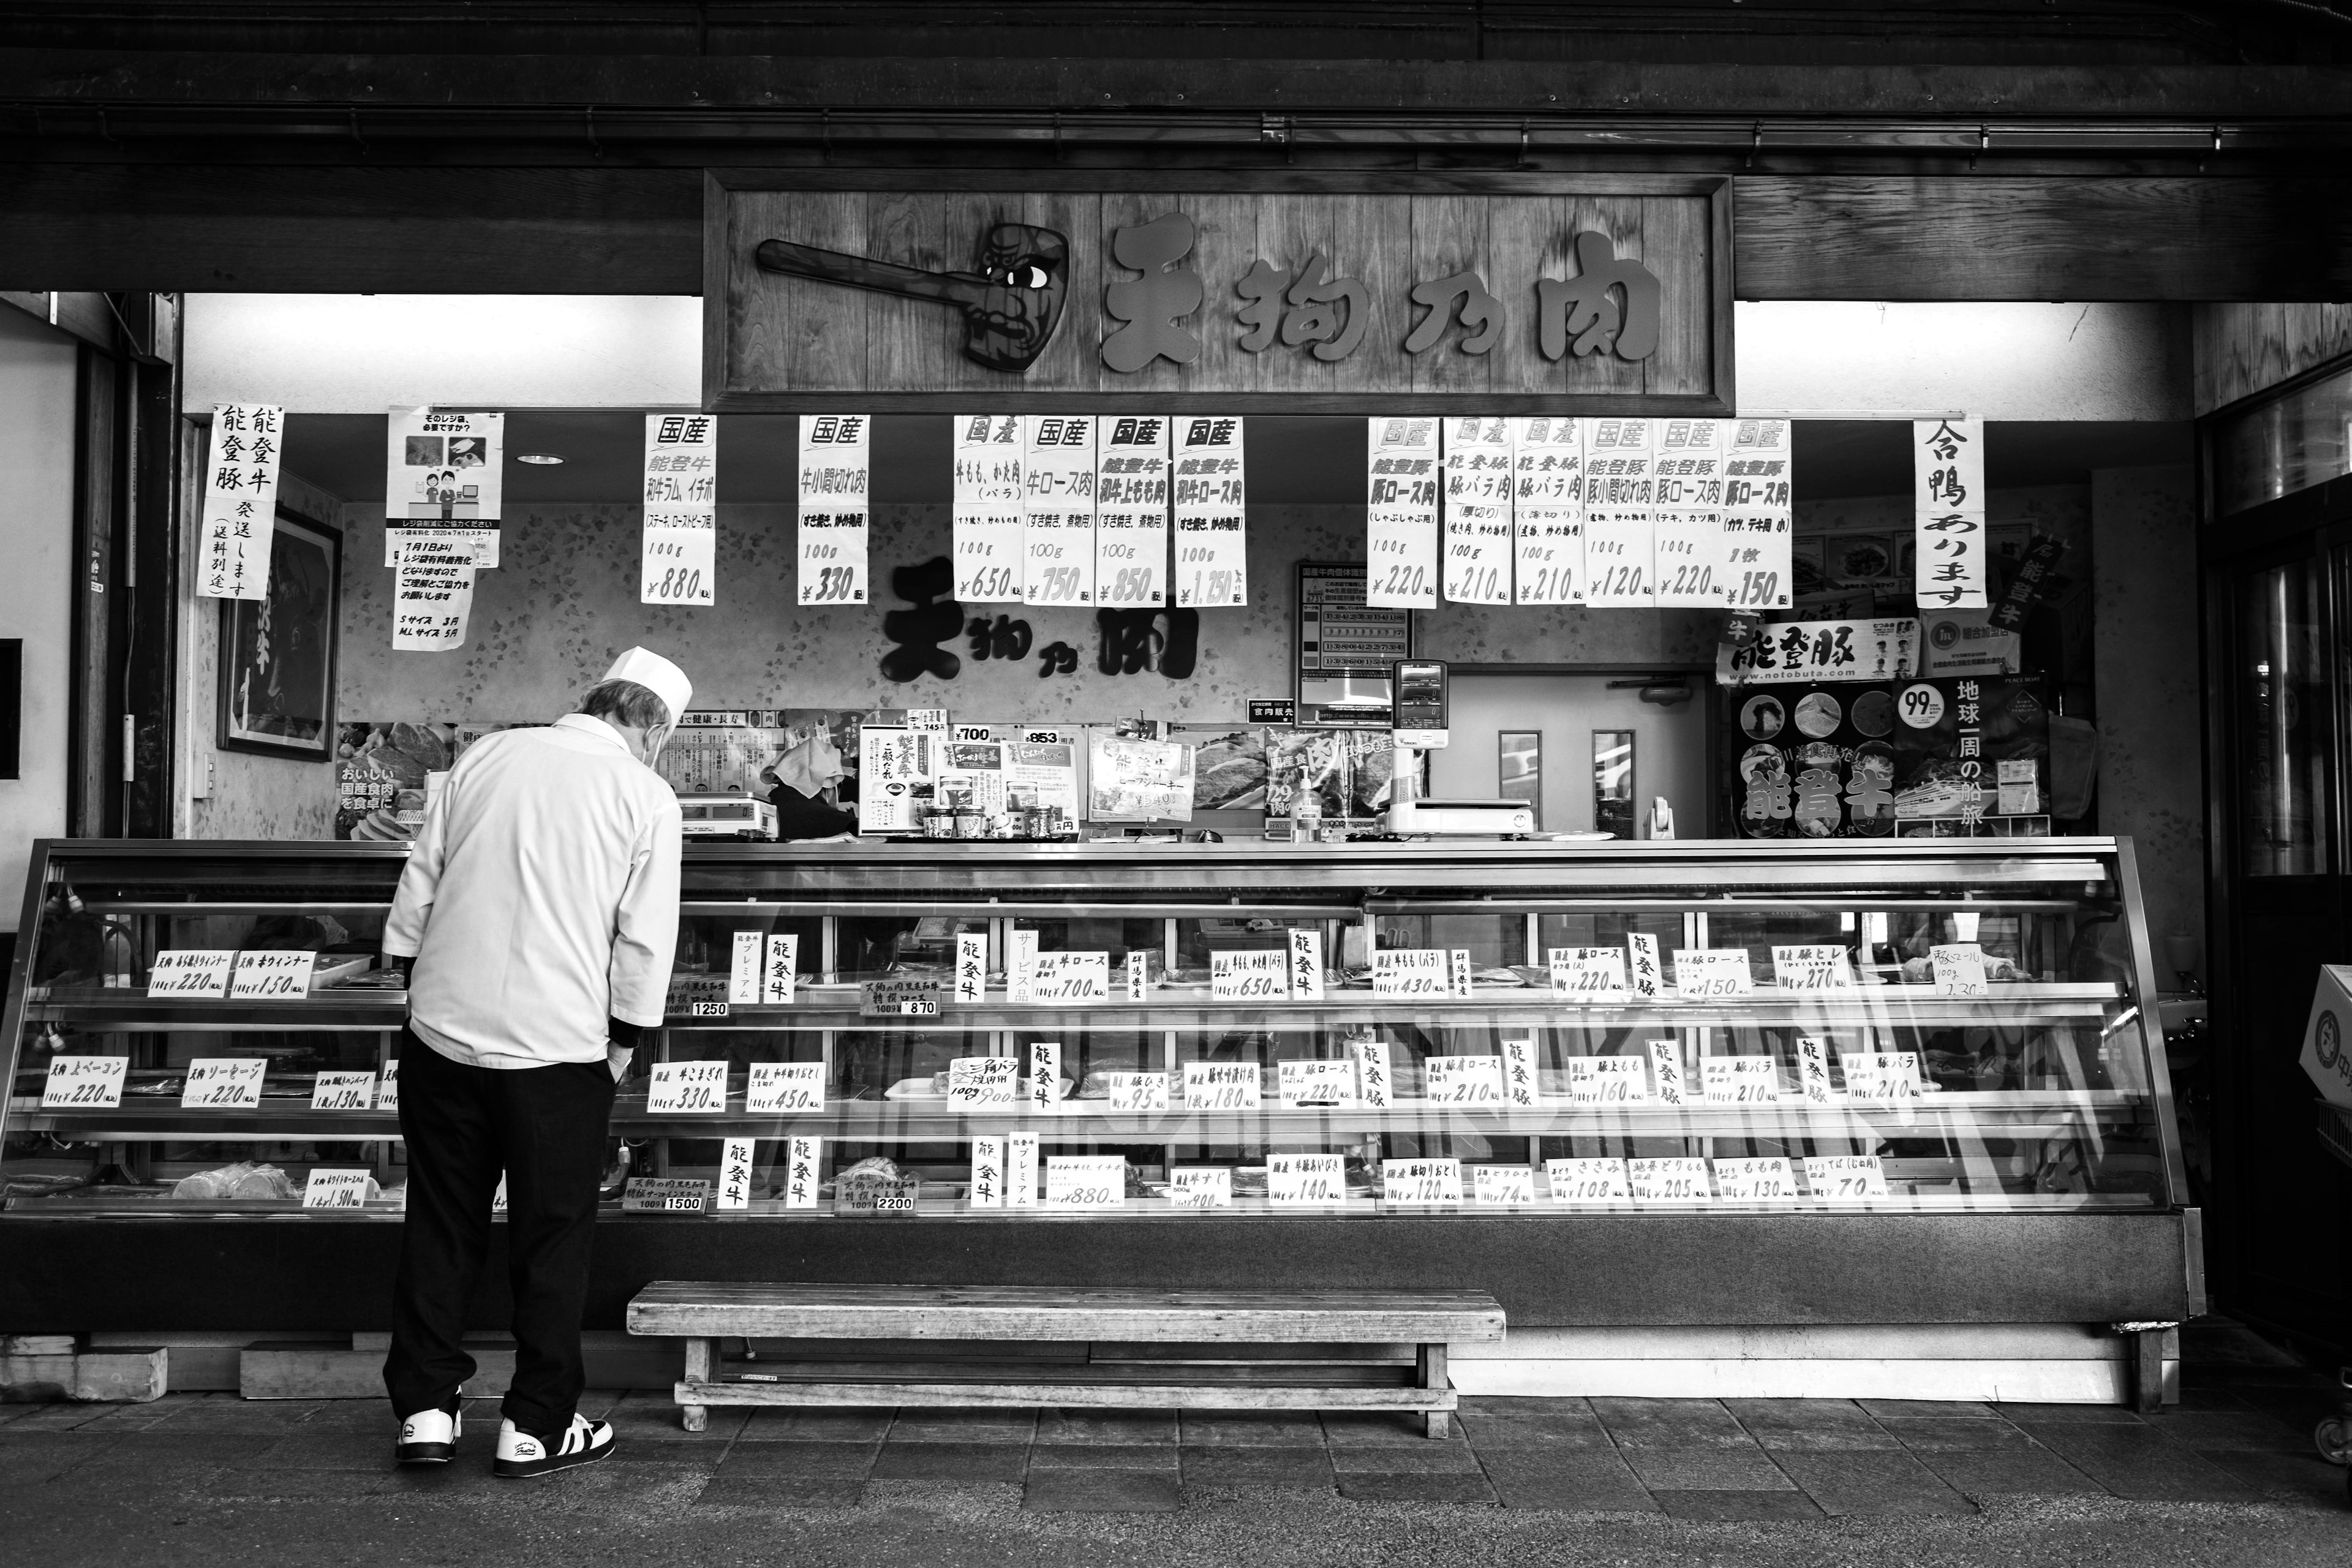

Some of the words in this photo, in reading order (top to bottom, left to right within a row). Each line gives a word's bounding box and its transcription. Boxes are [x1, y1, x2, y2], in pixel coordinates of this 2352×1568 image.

[1101, 212, 1660, 372] 天狗乃肉
[425, 415, 469, 423] そのレジ袋、
[657, 417, 710, 443] 国産
[811, 417, 864, 443] 国産
[966, 416, 1017, 443] 国産
[1037, 419, 1088, 445] 国産
[1110, 418, 1162, 445] 国産
[1456, 418, 1507, 442] 国産
[1526, 417, 1576, 443] 国産
[1185, 419, 1236, 446] 国産
[1381, 420, 1432, 445] 国産
[1595, 420, 1646, 447] 国産
[1664, 421, 1715, 447] 国産
[1733, 421, 1784, 447] 国産
[216, 405, 246, 489] 能登豚
[247, 408, 276, 494] 能登牛
[647, 456, 711, 472] 能登牛
[1101, 458, 1163, 474] 能登牛
[1177, 459, 1239, 475] 能登牛
[1371, 459, 1433, 475] 能登豚
[1447, 454, 1509, 470] 能登豚
[1517, 456, 1580, 471] 能登豚
[1586, 459, 1648, 475] 能登豚
[1656, 459, 1717, 475] 能登豚
[1725, 461, 1786, 477] 能登豚
[801, 467, 866, 494] 牛小間切れ肉
[1027, 470, 1093, 496] 牛ロース肉
[1099, 478, 1166, 504] 和牛上もも肉
[1177, 479, 1242, 505] 和牛ロース肉
[1370, 478, 1435, 506] 豚ロース肉
[1447, 475, 1510, 501] 豚バラ肉
[1517, 475, 1582, 501] 豚バラ肉
[1586, 478, 1651, 504] 豚小間切れ肉
[1656, 478, 1721, 504] 豚ロース肉
[1725, 480, 1789, 507] 豚ロース肉
[402, 519, 492, 529] レジ袋削減にご協力ください
[1918, 420, 1981, 606] 合鴨あります
[229, 502, 254, 597] 発送します
[649, 542, 683, 558] 100g
[1030, 543, 1063, 559] 100g
[1182, 548, 1215, 562] 100g
[1450, 545, 1482, 559] 100g
[1591, 541, 1624, 555] 100g
[401, 579, 470, 589] ご理解とご協力を
[402, 567, 458, 576] となりますので
[401, 591, 451, 601] お願いします
[1731, 625, 1856, 671] 能登豚
[1905, 691, 1930, 715] 99
[1957, 680, 1983, 825] 地球一周の船旅
[341, 769, 394, 780] おいしい
[341, 782, 393, 796] 国産食肉
[1746, 769, 1893, 820] 能登牛
[341, 797, 393, 810] を食卓に
[1060, 953, 1105, 968] 牛ロース
[1294, 934, 1314, 997] 能登牛
[1577, 948, 1619, 960] 豚ロース
[1634, 935, 1657, 997] 能登豚
[1690, 955, 1744, 965] 豚ロース
[739, 944, 753, 998] プレミアム
[770, 940, 792, 1001] 能登牛
[960, 940, 982, 1001] 能登牛
[1015, 933, 1031, 1002] サービス品
[1131, 955, 1142, 998] 群馬県産
[1455, 953, 1468, 996] 群馬県産
[695, 1003, 726, 1016] 1250
[910, 1001, 935, 1014] 870
[70, 1060, 121, 1076] 上ベーコン
[1304, 1064, 1349, 1075] 豚ロース
[1509, 1043, 1532, 1106] 能登豚
[1654, 1042, 1681, 1104] 能登豚
[1733, 1061, 1772, 1073] 豚バラ
[1801, 1040, 1828, 1103] 能登豚
[1876, 1055, 1914, 1068] 豚バラ
[1035, 1045, 1054, 1108] 能登牛
[1364, 1045, 1385, 1107] 能登豚
[951, 1087, 980, 1101] 100g
[726, 1144, 748, 1205] 能登牛
[791, 1139, 812, 1203] 能登牛
[976, 1141, 998, 1202] 能登牛
[1017, 1148, 1029, 1204] プレミアム
[1578, 1159, 1619, 1174] ささみ
[1744, 1161, 1782, 1172] もも肉
[668, 1198, 699, 1209] 1500
[878, 1199, 912, 1209] 2200
